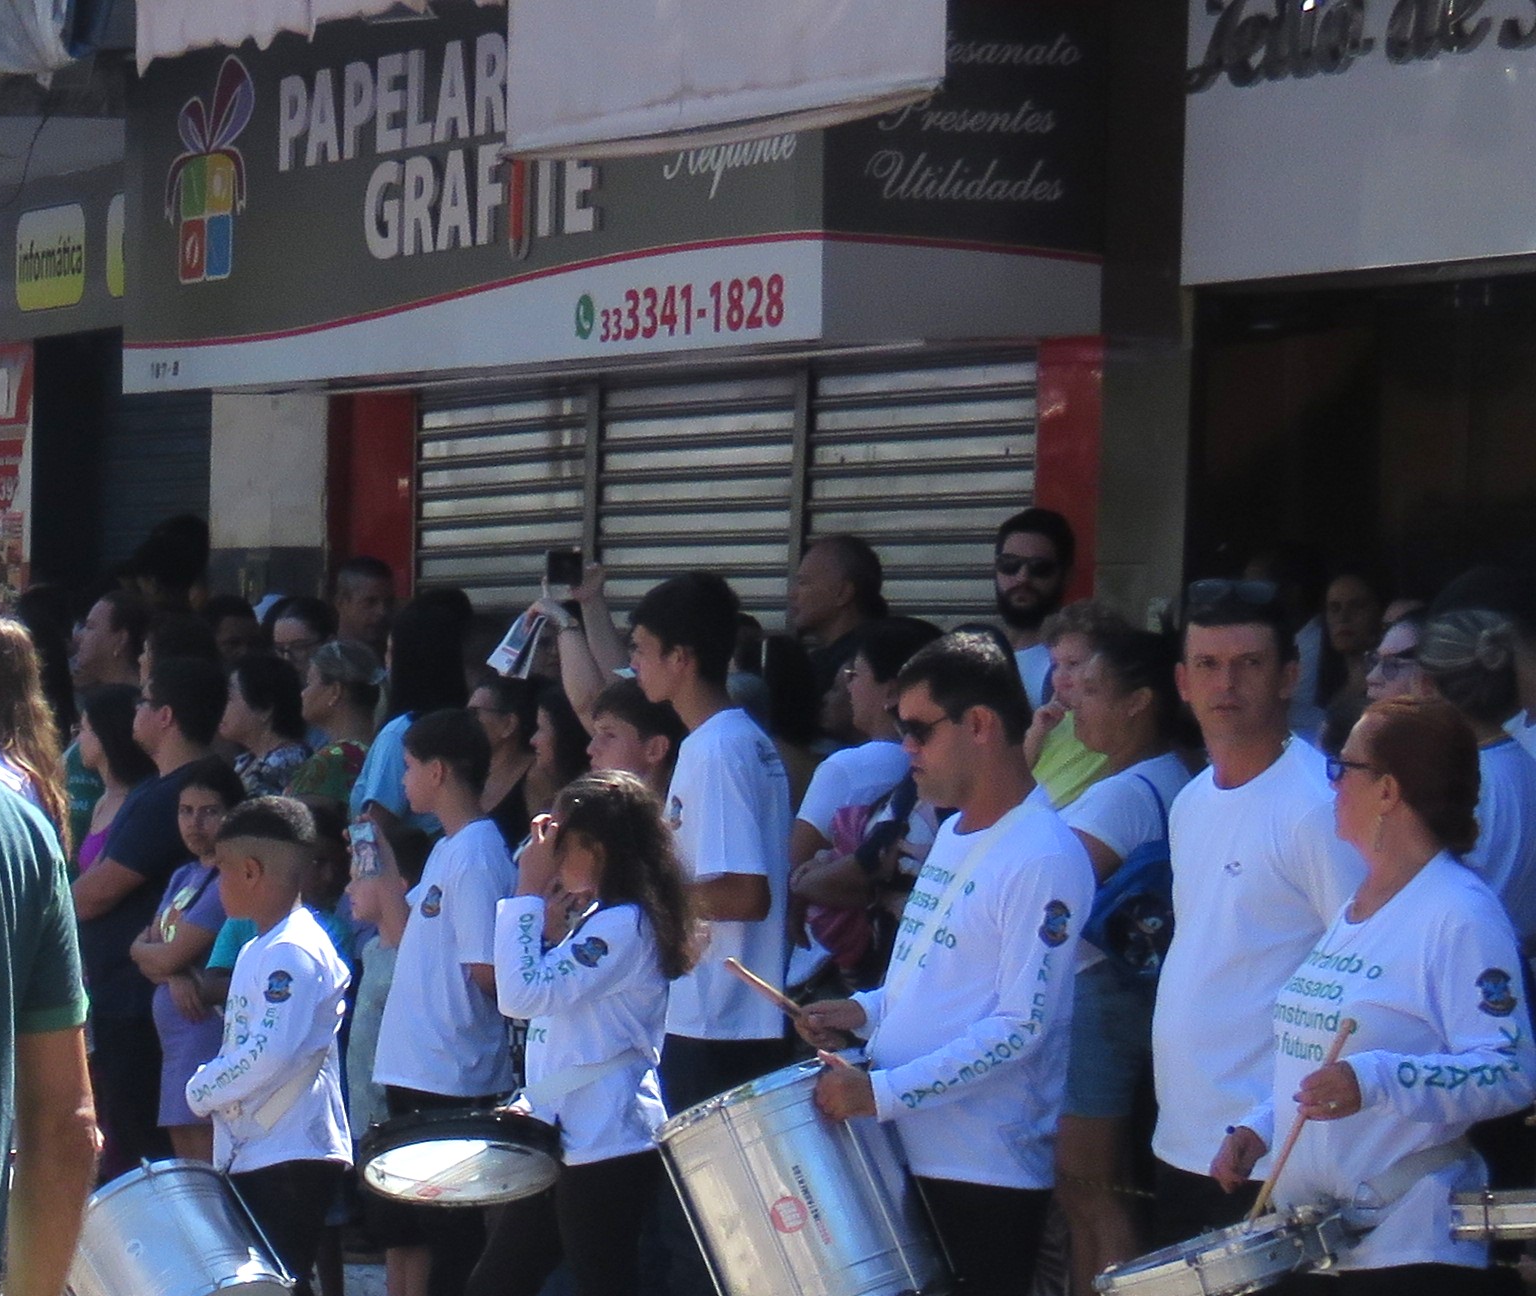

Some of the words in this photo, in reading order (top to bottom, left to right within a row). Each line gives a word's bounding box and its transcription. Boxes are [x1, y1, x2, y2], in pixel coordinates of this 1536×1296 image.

[945, 32, 1082, 66] esanato
[278, 31, 508, 172] PAPELAR
[878, 98, 1056, 133] Presentes
[864, 149, 1064, 201] Utilidades
